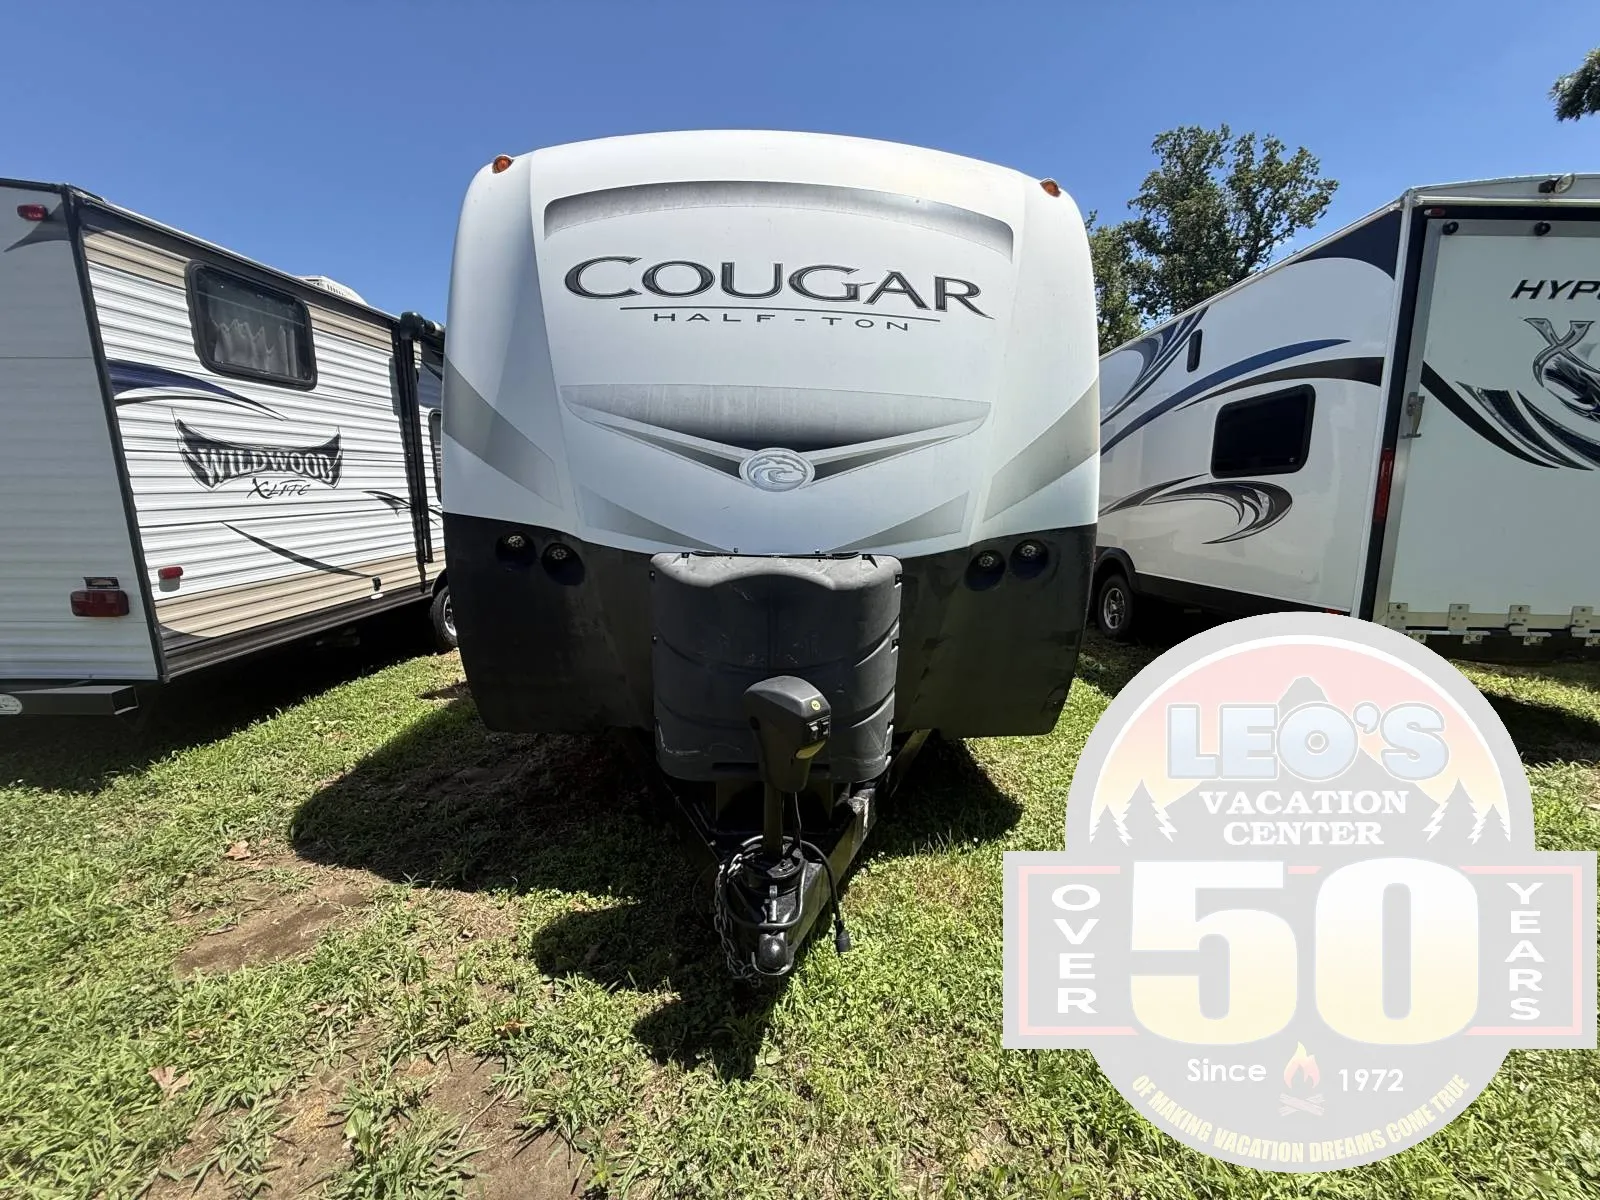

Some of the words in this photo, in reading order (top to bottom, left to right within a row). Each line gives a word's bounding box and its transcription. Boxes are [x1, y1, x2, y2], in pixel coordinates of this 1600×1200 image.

[564, 256, 994, 319] COUGAR
[1510, 279, 1600, 300] HYP
[194, 447, 334, 487] WILDWOOD
